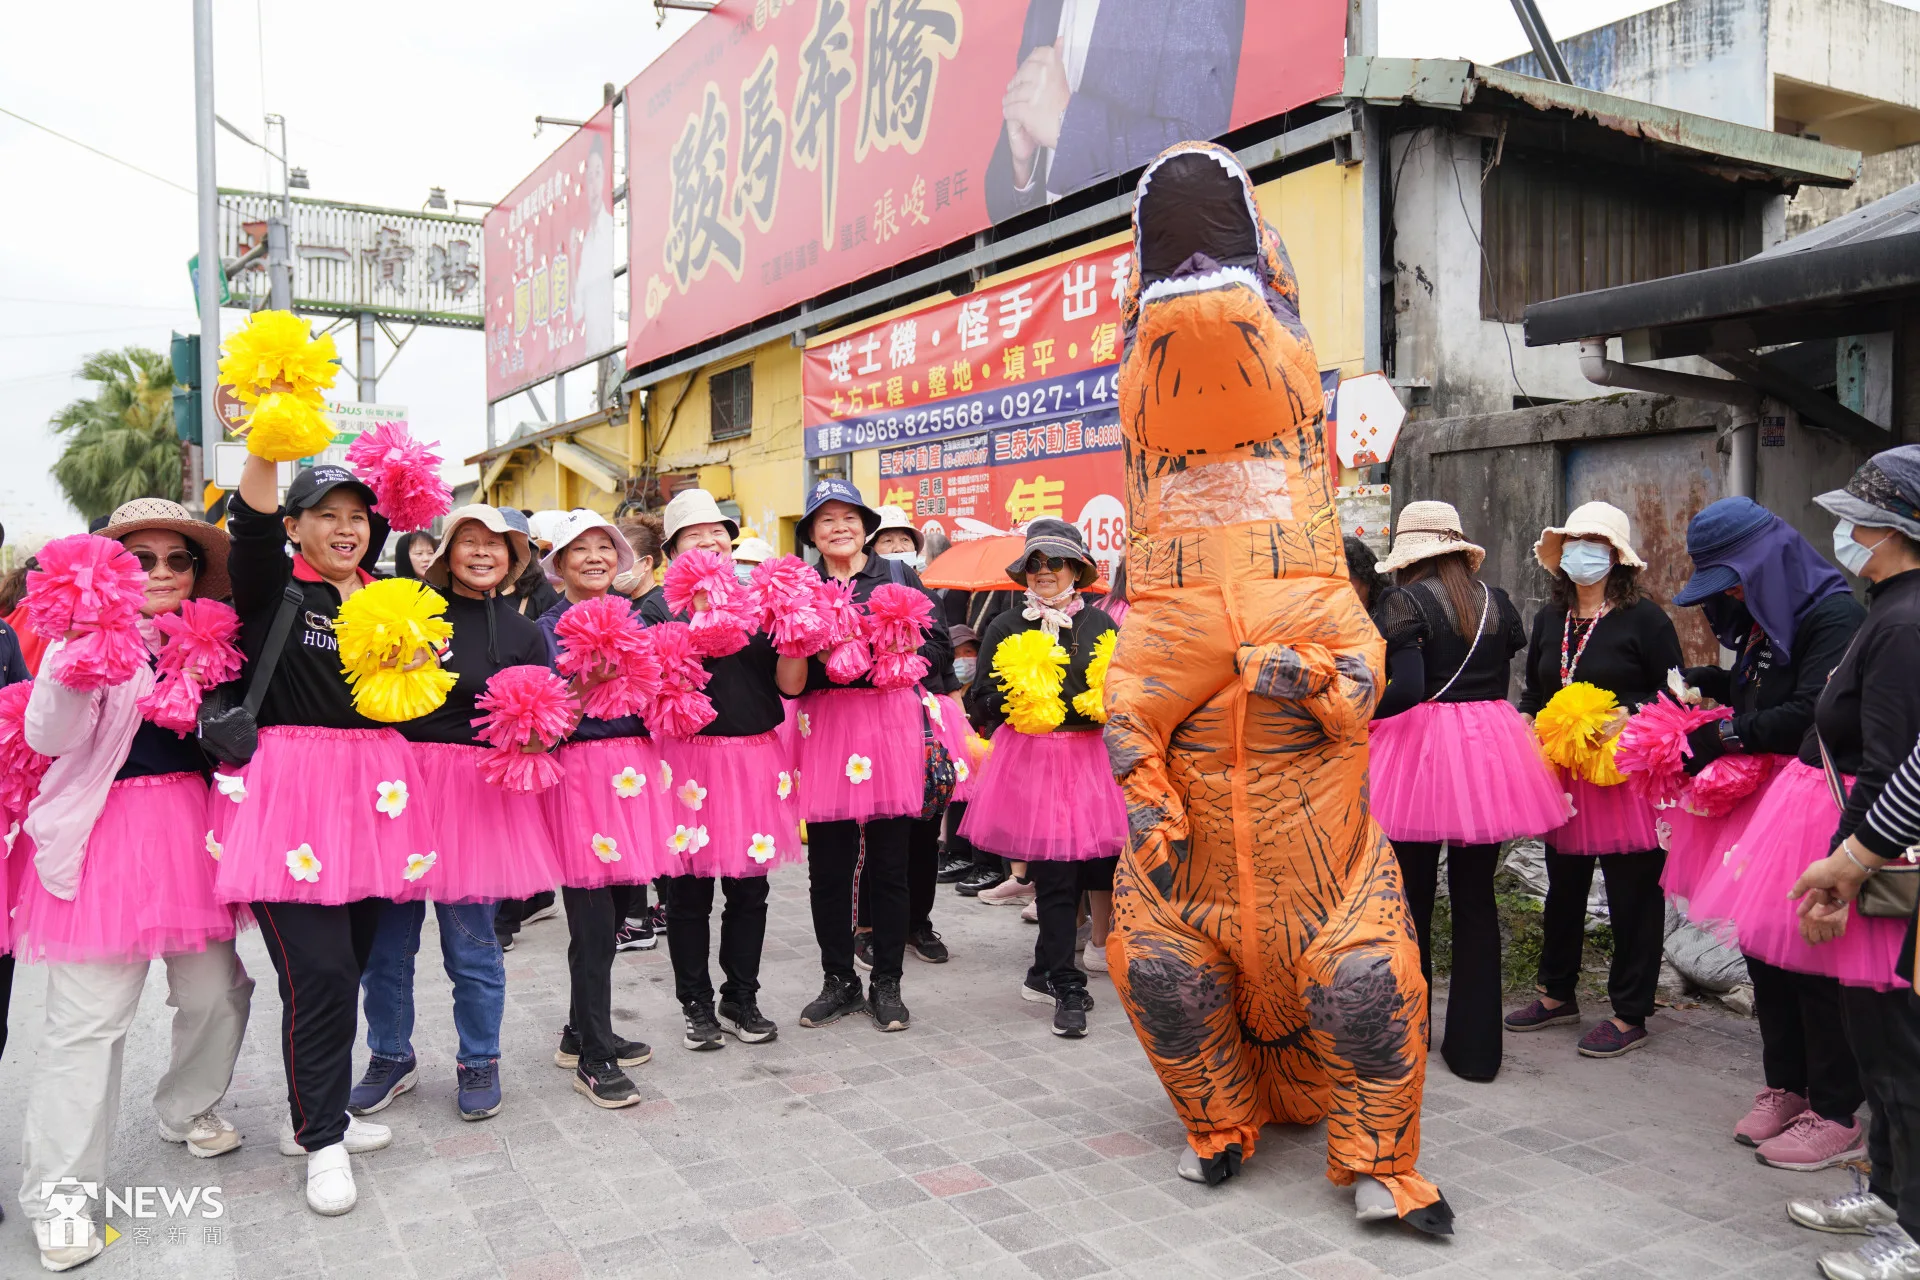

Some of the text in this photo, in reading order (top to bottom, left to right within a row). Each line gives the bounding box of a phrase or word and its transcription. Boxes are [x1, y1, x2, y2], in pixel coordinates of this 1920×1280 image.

[873, 174, 930, 245] 張峻
[934, 168, 969, 213] 賀年
[994, 419, 1082, 461] 三泰不動產
[880, 444, 942, 475] 三泰不動產
[919, 477, 944, 497] 瑞穗
[916, 497, 947, 517] 芒果園
[1083, 516, 1125, 552] 158
[303, 630, 340, 652] HUN
